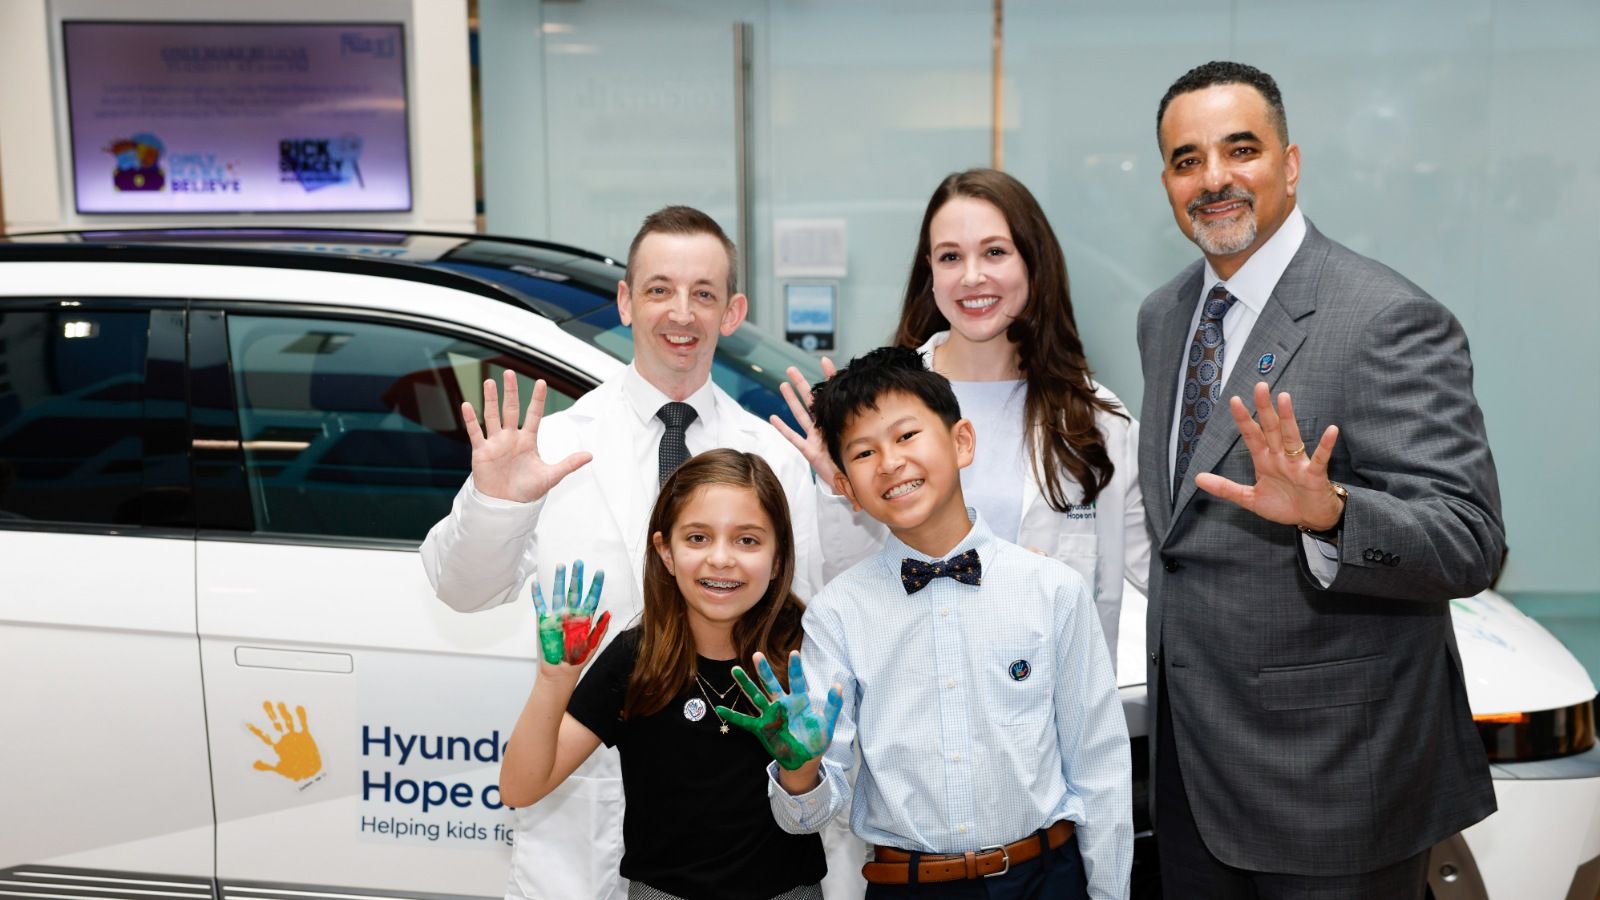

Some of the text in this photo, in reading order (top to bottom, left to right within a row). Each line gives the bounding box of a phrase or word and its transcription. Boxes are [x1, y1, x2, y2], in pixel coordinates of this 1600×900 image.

[1066, 511, 1083, 520] Hope
[362, 725, 509, 765] Hyund
[362, 770, 473, 813] Hope
[481, 785, 515, 811] o
[361, 815, 440, 841] Helping
[447, 821, 487, 840] kids
